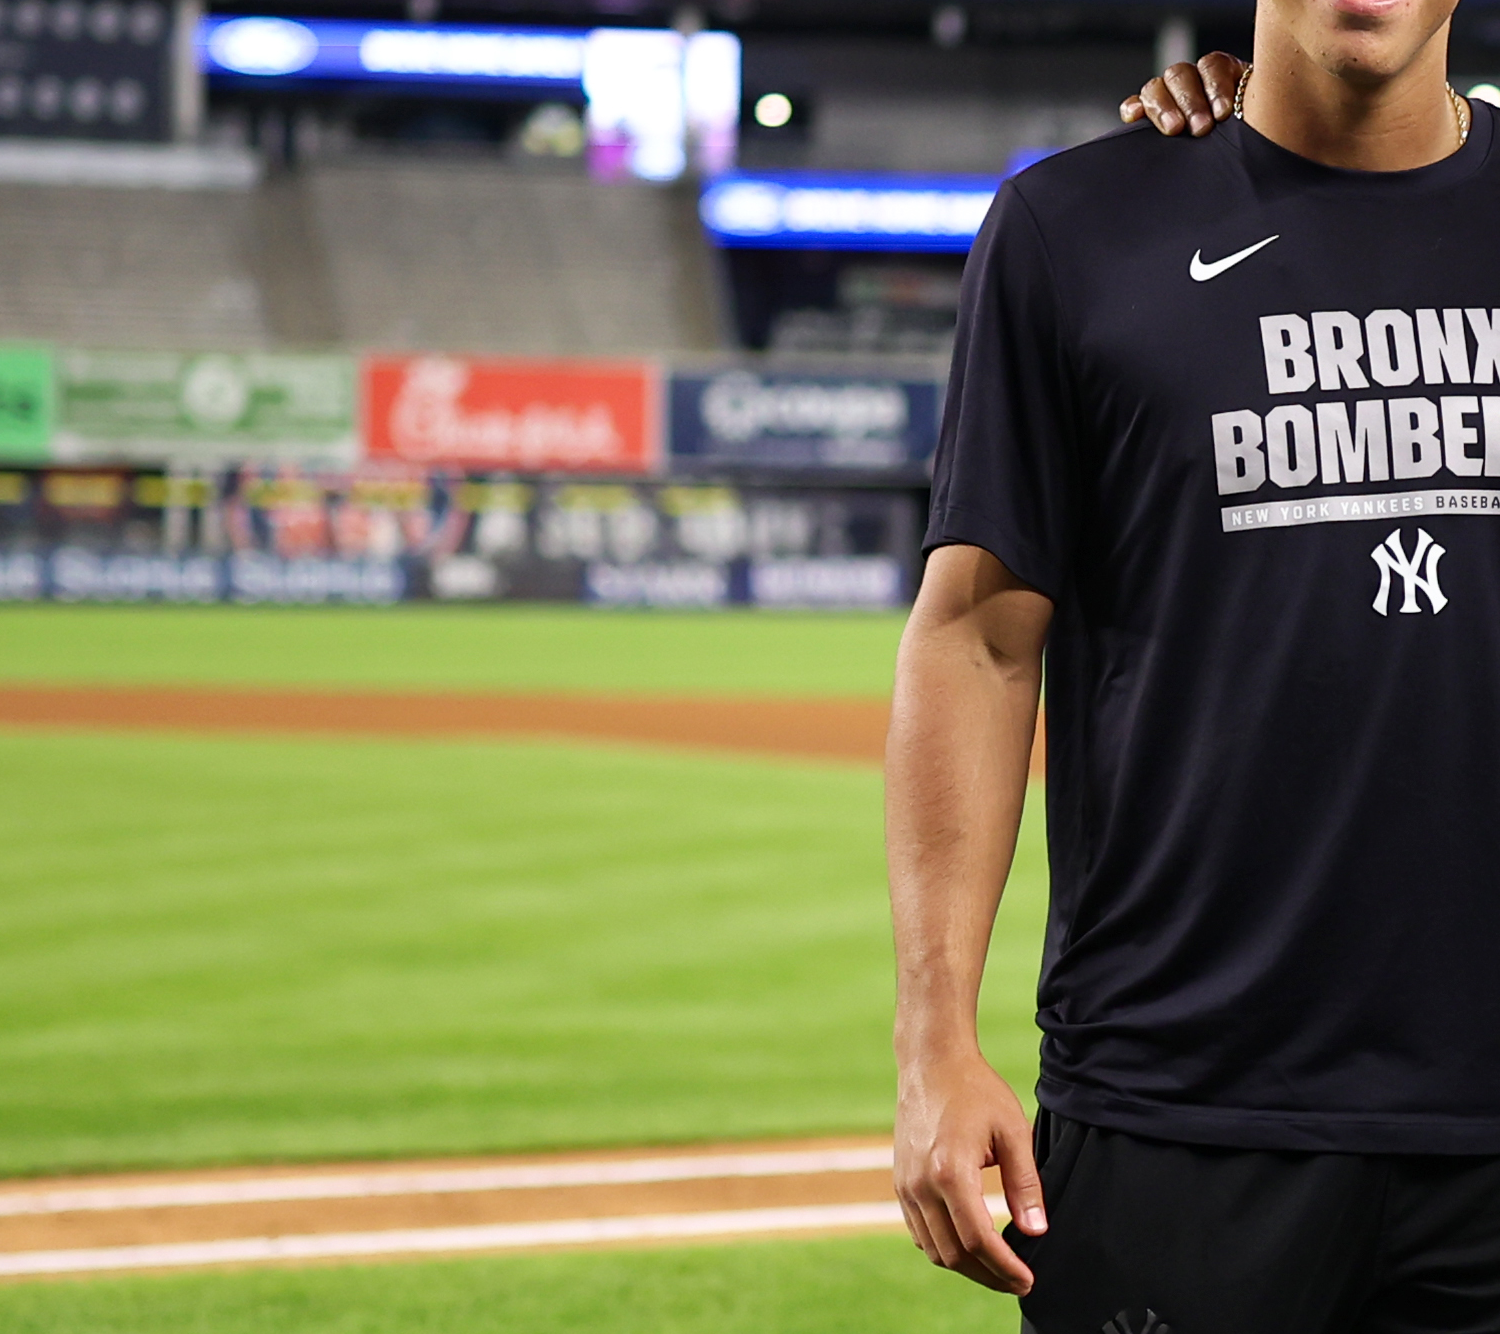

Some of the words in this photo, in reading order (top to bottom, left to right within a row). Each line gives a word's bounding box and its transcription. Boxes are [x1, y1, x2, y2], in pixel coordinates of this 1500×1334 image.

[1231, 508, 1269, 527] NEW
[1280, 501, 1330, 520] YORK
[1340, 496, 1424, 517] YANKEES
[1370, 526, 1449, 617] NY
